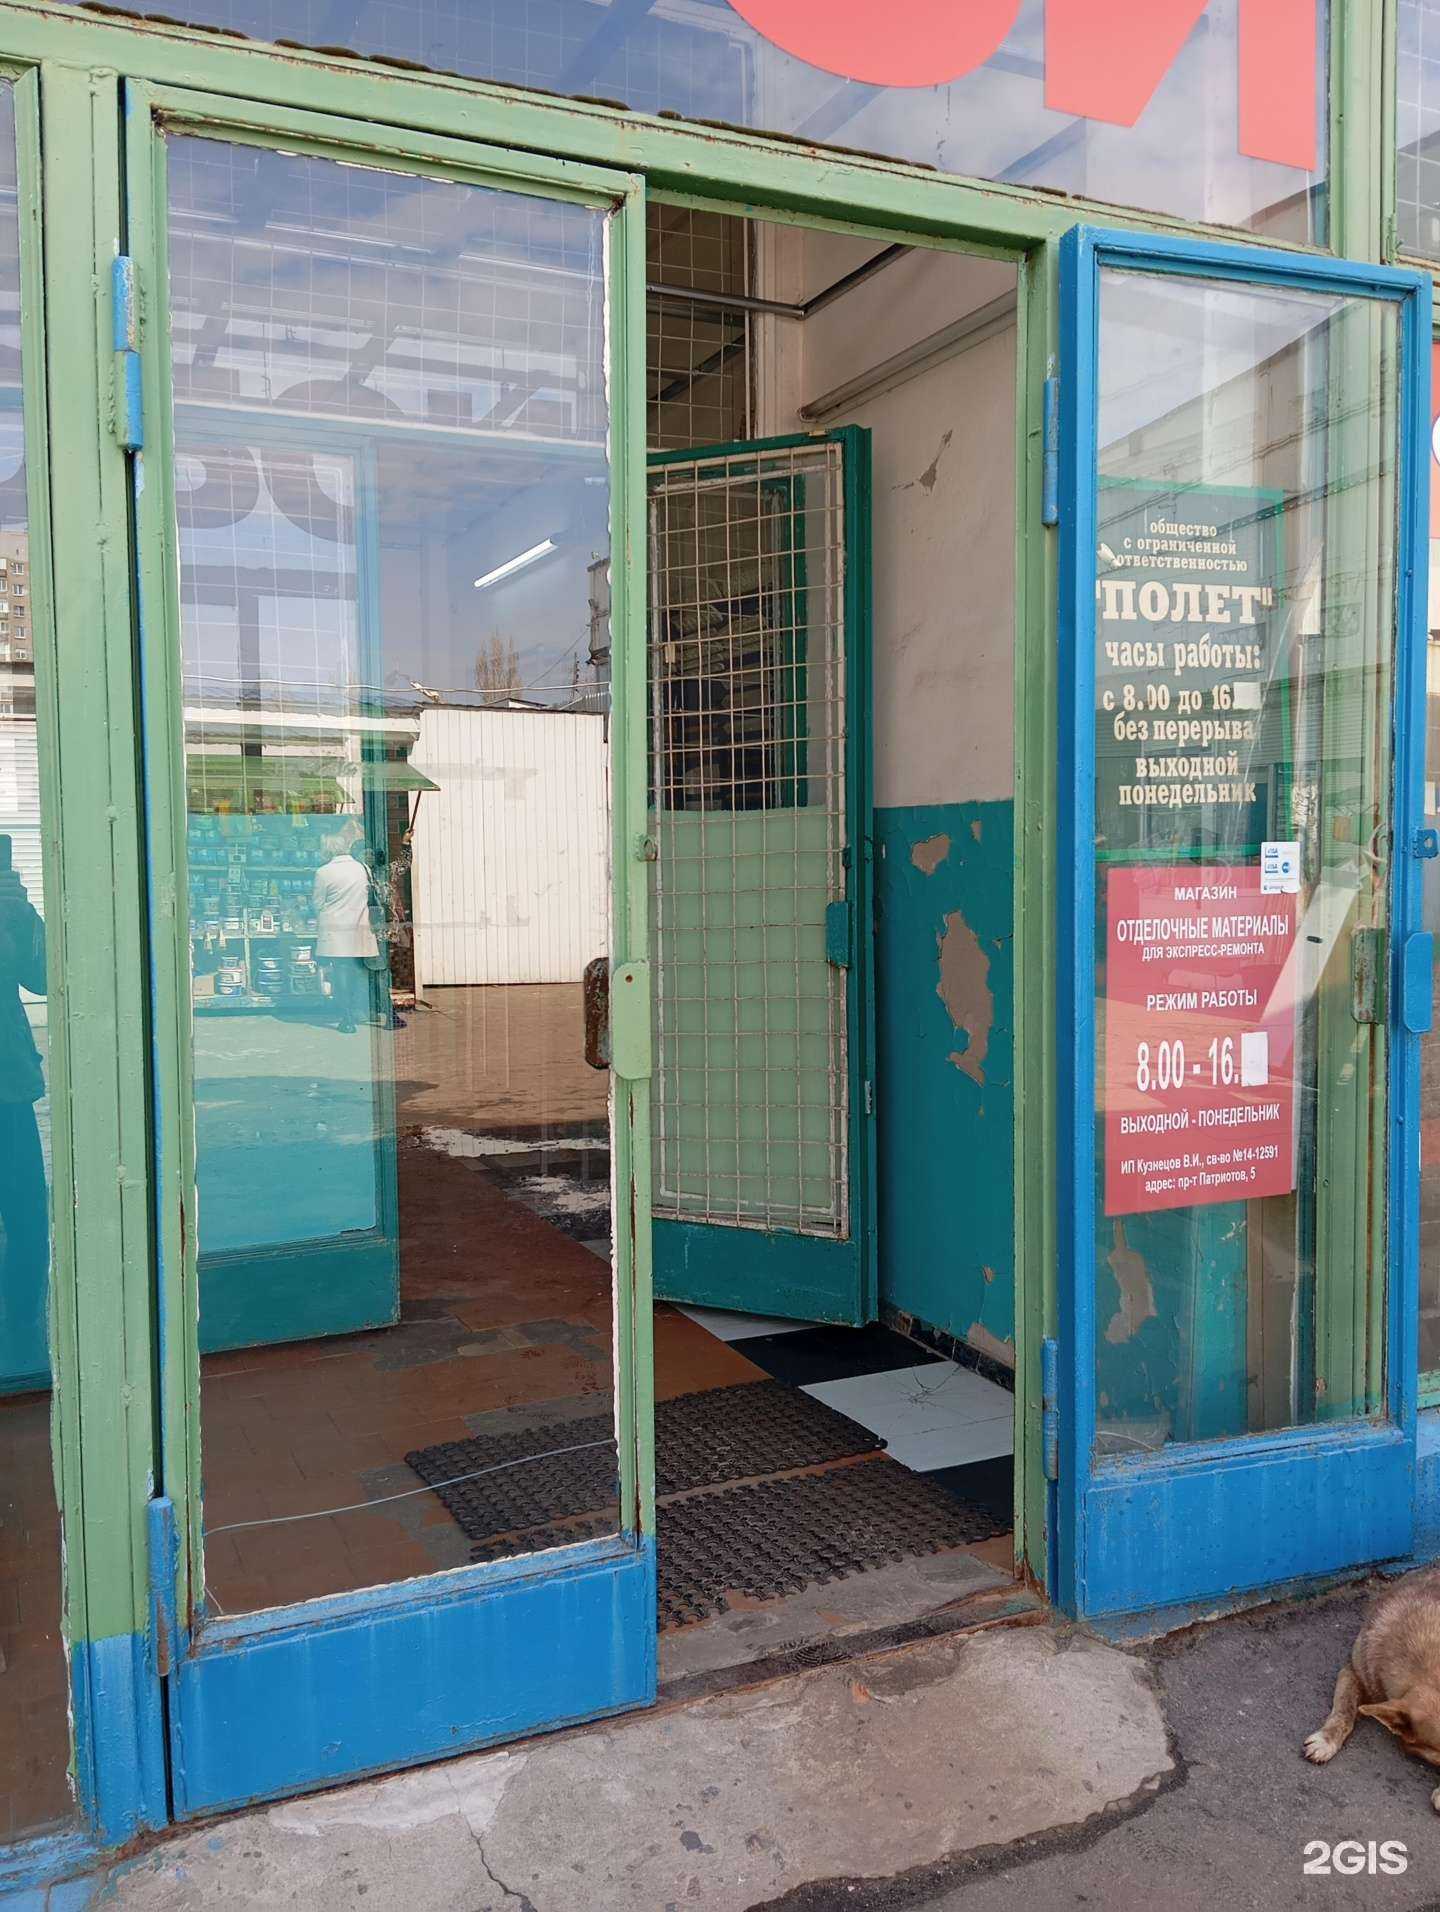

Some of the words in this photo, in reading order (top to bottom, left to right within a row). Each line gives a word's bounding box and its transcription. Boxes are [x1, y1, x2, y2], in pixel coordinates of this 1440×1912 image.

[1150, 519, 1217, 537] общество
[1123, 537, 1132, 549] с
[1137, 538, 1237, 555] ограниченной
[1117, 554, 1247, 572] ответственностью
[1104, 640, 1165, 667] часы
[1173, 632, 1262, 676] работы:
[1103, 690, 1115, 711] с
[1123, 684, 1170, 711] 8.00
[1178, 690, 1203, 715] до
[1114, 711, 1149, 741] без
[1153, 719, 1257, 747] перерыва
[1135, 750, 1239, 781] выходной
[1118, 783, 1257, 808] понедельник
[1174, 886, 1237, 901] МАГАЗИН
[1116, 916, 1209, 945] ОТДЕЛОЧНЫЕ
[1211, 915, 1289, 938] МАТЕРИАЛЫ
[1142, 945, 1164, 962] ДЛЯ
[1166, 942, 1265, 959] ЭКСПРЕСС-РЕМОНТА
[1146, 992, 1198, 1011] РЕЖИМ
[1201, 989, 1257, 1008] РАБОТЫ
[1136, 1039, 1185, 1092] 8.00
[1120, 1108, 1189, 1134] ВЫХОДНОЙ
[1198, 1104, 1280, 1127] ПОНЕДЕЛЬНИК
[1121, 1159, 1135, 1174] ИП
[1137, 1157, 1181, 1174] Кузнецов
[1206, 1152, 1231, 1165] св-во
[1145, 1178, 1176, 1194] адрес:
[1178, 1176, 1198, 1190] пр-т
[1250, 1166, 1256, 1180] 5
